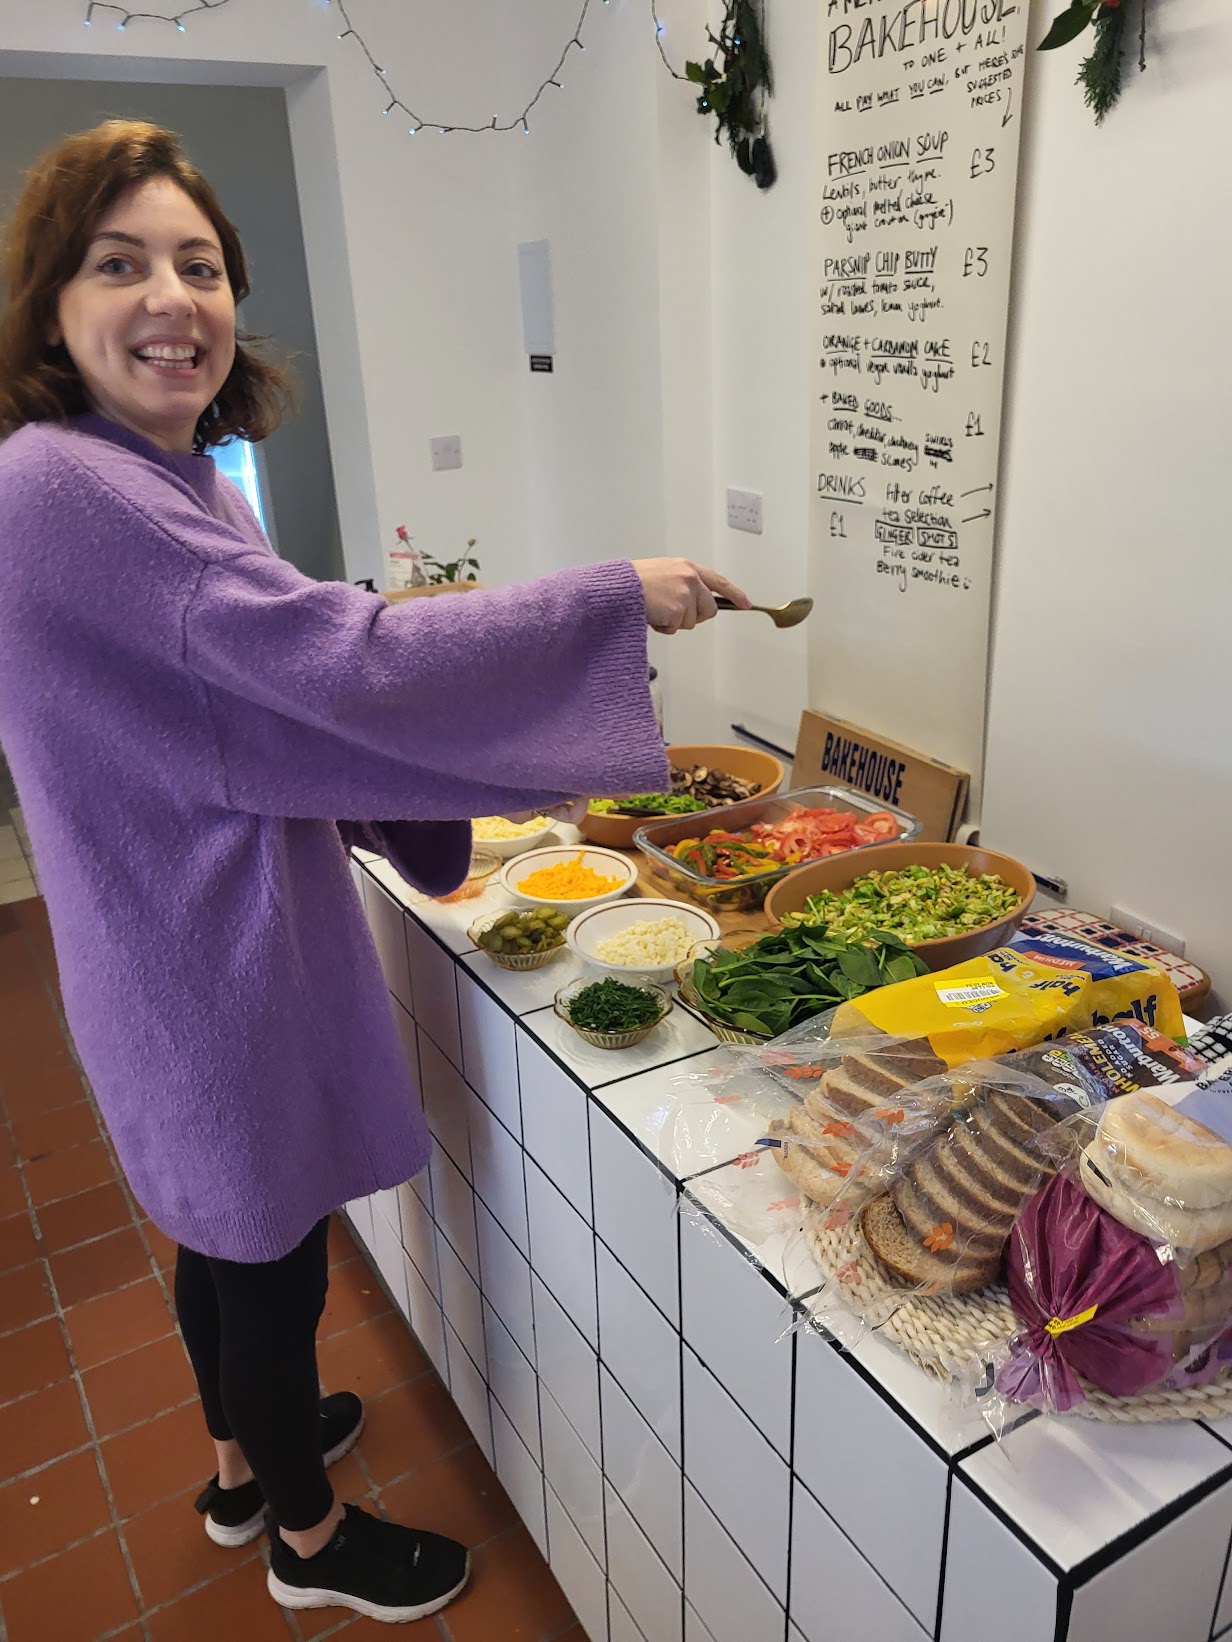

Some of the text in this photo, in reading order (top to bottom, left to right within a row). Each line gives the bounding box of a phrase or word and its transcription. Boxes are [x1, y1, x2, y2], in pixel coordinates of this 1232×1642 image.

[903, 61, 914, 71] TO
[921, 48, 947, 69] ONE
[974, 25, 1006, 51] ALL!
[834, 100, 852, 112] ALL
[856, 92, 873, 110] PAY
[908, 80, 925, 96] YOU
[828, 131, 949, 176] FRENCH ONION SOUP
[970, 148, 995, 179] £3
[868, 176, 901, 193] butter
[824, 246, 938, 278] PARSNIP CHIP BUTTY
[963, 247, 989, 277] £3
[823, 334, 861, 352] ORANGE
[924, 339, 951, 357] CAKE
[971, 341, 992, 368] £2
[829, 353, 861, 376] optional
[832, 391, 859, 409] BAKED
[965, 411, 984, 437] £1
[818, 473, 866, 498] DRINKS
[830, 511, 847, 539] £1
[881, 507, 900, 523] tea
[876, 525, 956, 548] GINGER SHOTS
[939, 552, 960, 567] tea
[876, 560, 907, 592] Berry
[821, 731, 906, 805] BAKEHOUSE
[1030, 979, 1081, 997] half
[1141, 1026, 1160, 1040] 55
[1097, 1038, 1134, 1078] NO ADDED
[1109, 1044, 1134, 1071] SUGAR
